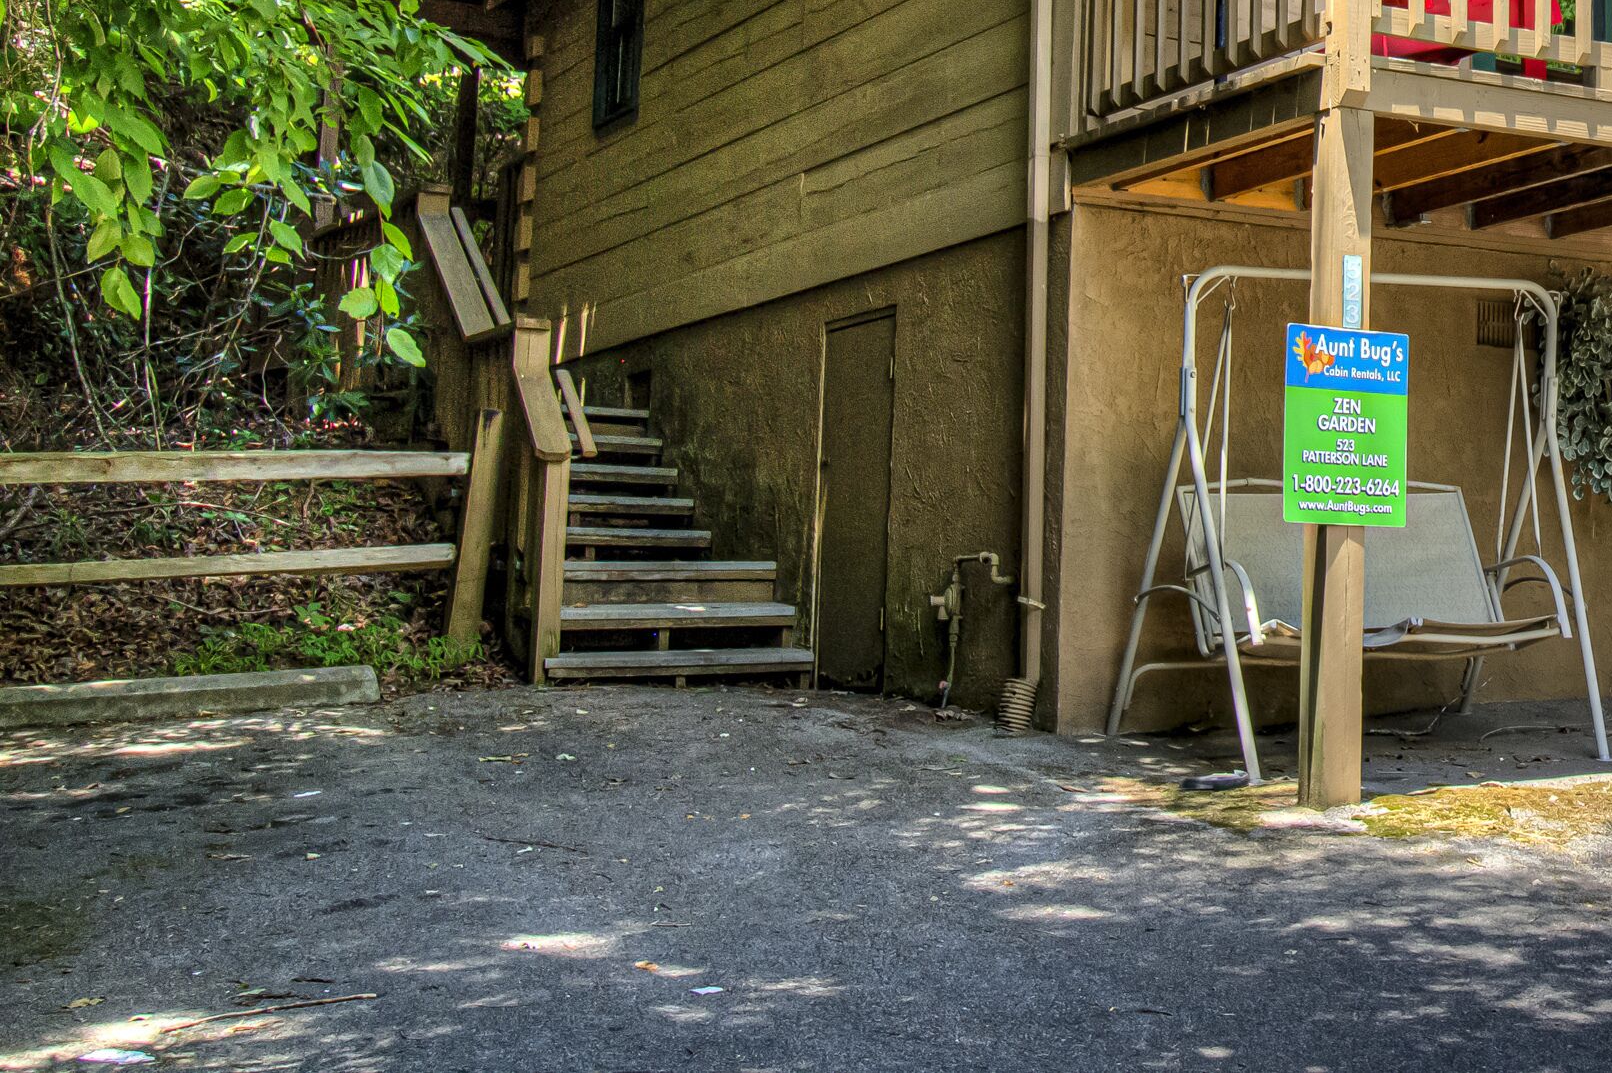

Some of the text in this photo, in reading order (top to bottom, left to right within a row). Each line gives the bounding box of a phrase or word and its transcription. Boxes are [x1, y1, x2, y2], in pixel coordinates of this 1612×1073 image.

[1315, 334, 1404, 367] Aunt Bug's
[1323, 365, 1401, 382] Cabin Rentals, LLC
[1333, 397, 1361, 415] ZEN
[1317, 414, 1376, 433] GARDEN
[1336, 439, 1355, 452] 523
[1302, 450, 1388, 467] PATTERSON LANE
[1292, 473, 1400, 497] 1-800-223-6264
[1298, 499, 1393, 515] www.AuntBugs.com
